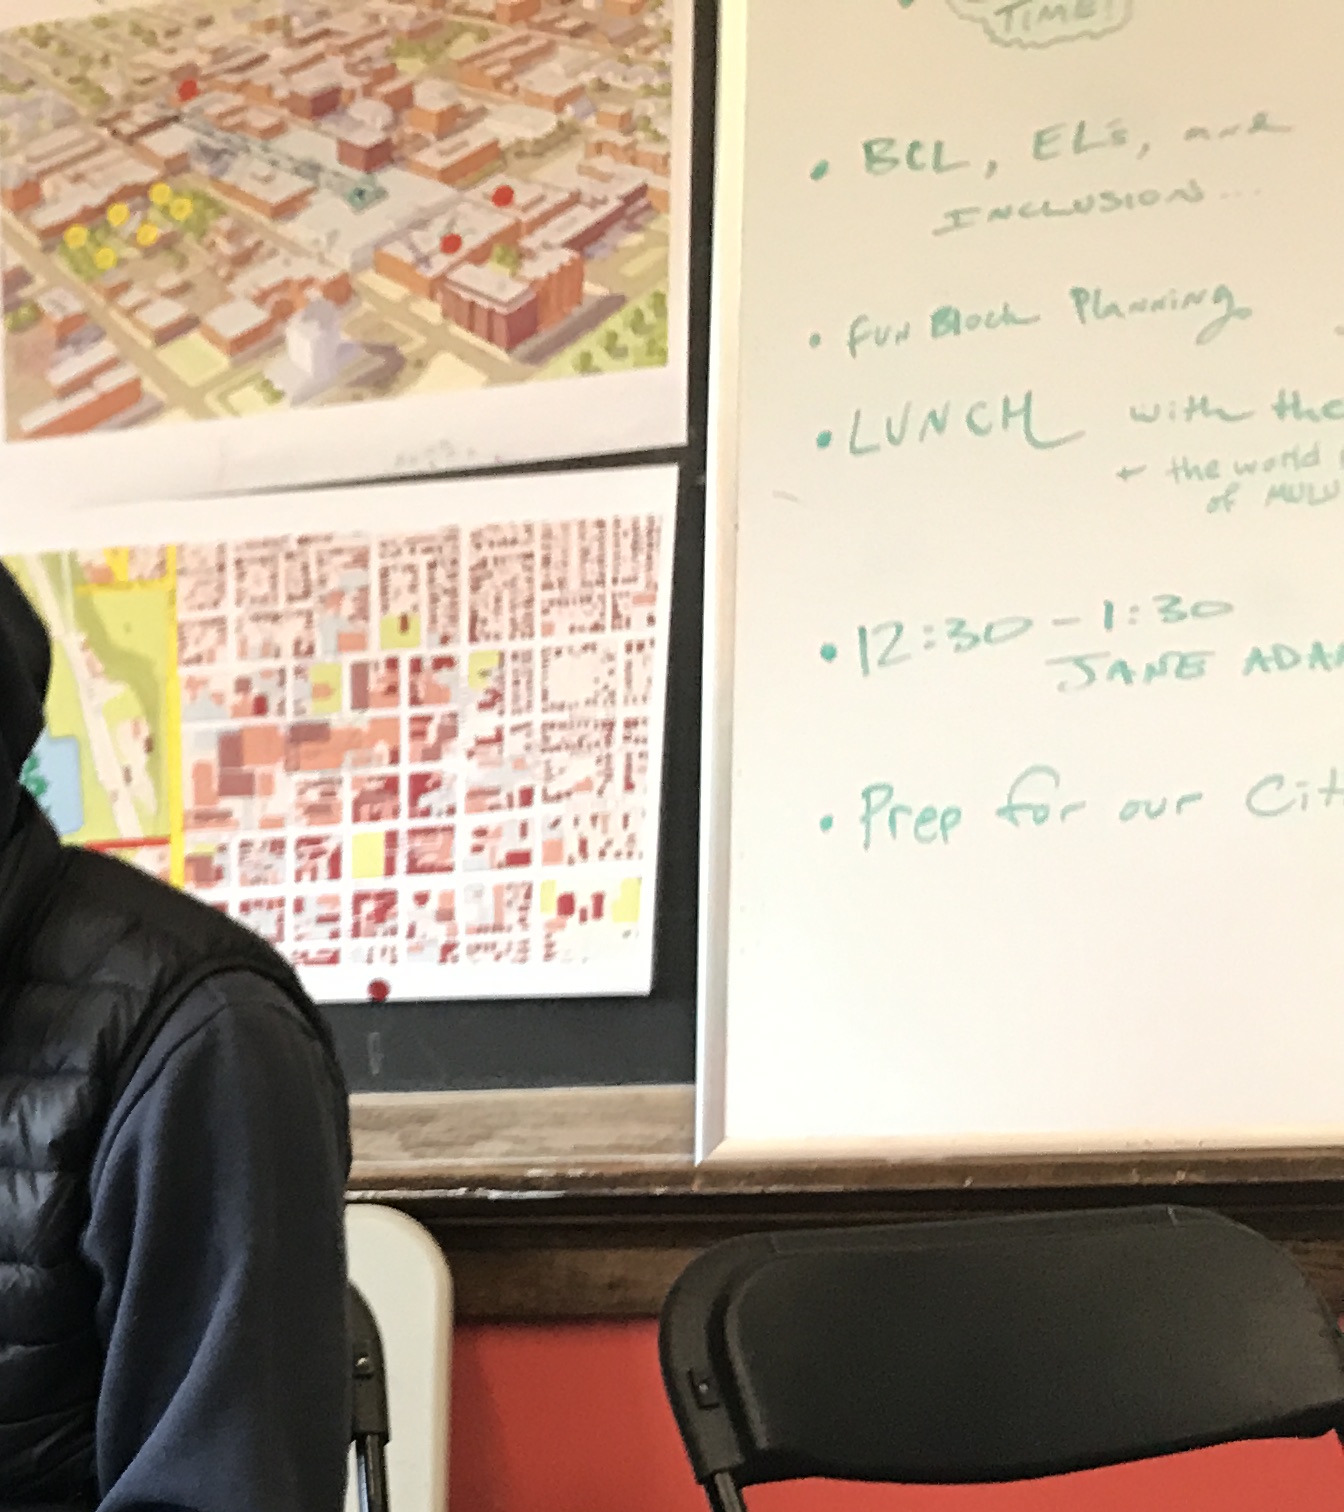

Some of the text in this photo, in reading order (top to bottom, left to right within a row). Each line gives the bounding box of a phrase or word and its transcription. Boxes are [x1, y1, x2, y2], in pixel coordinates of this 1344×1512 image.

[1182, 109, 1296, 142] and
[1068, 283, 1254, 346] Planning
[848, 389, 1086, 456] LUNCH
[1128, 394, 1256, 423] with
[1166, 455, 1221, 484] the
[1044, 639, 1344, 693] JANE ADA
[859, 781, 963, 852] Prep
[995, 764, 1088, 828] for
[1118, 791, 1204, 824] our
